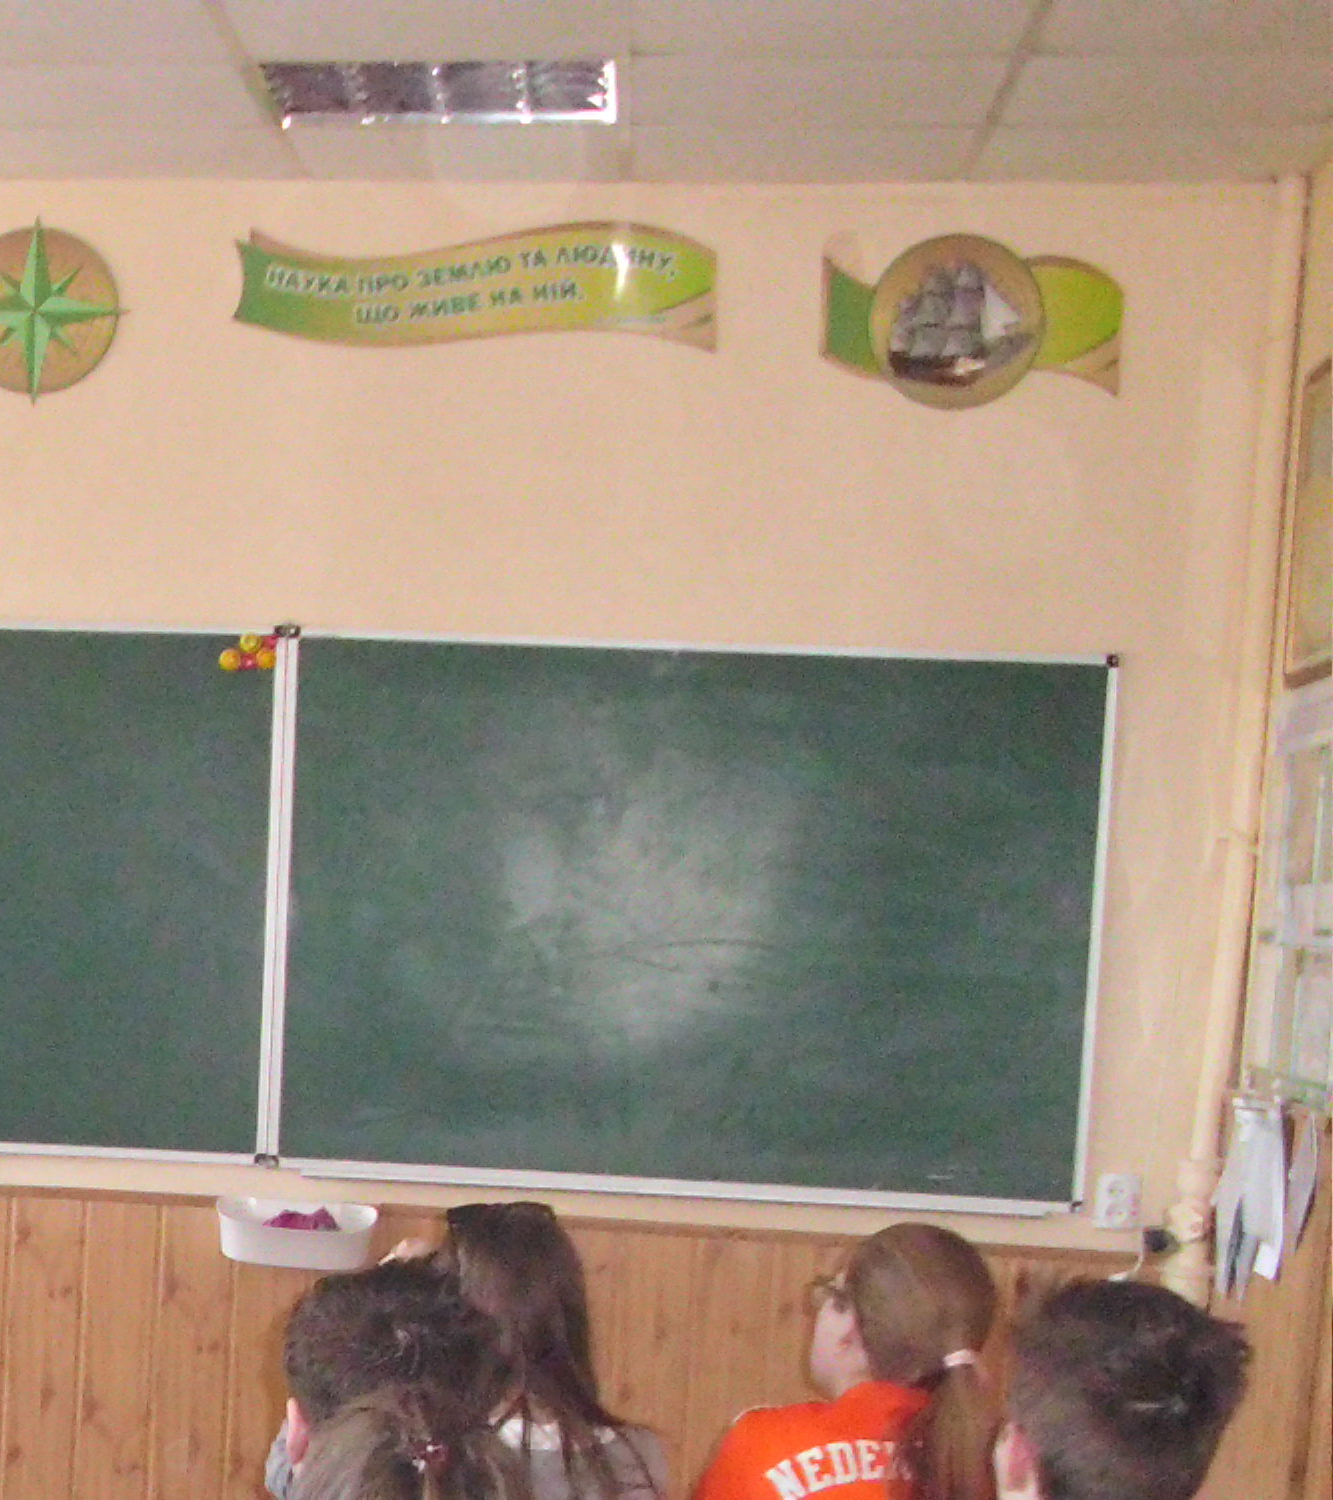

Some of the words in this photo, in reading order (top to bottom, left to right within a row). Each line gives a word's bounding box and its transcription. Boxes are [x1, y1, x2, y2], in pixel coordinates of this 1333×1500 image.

[266, 265, 349, 294] НАУКА
[357, 273, 410, 294] ПРО
[416, 255, 511, 287] ЗЕМЛЮ
[520, 249, 547, 268] ТА
[354, 303, 400, 324] ЩО
[409, 293, 480, 319] ЖИВЕ
[490, 287, 522, 306] НА
